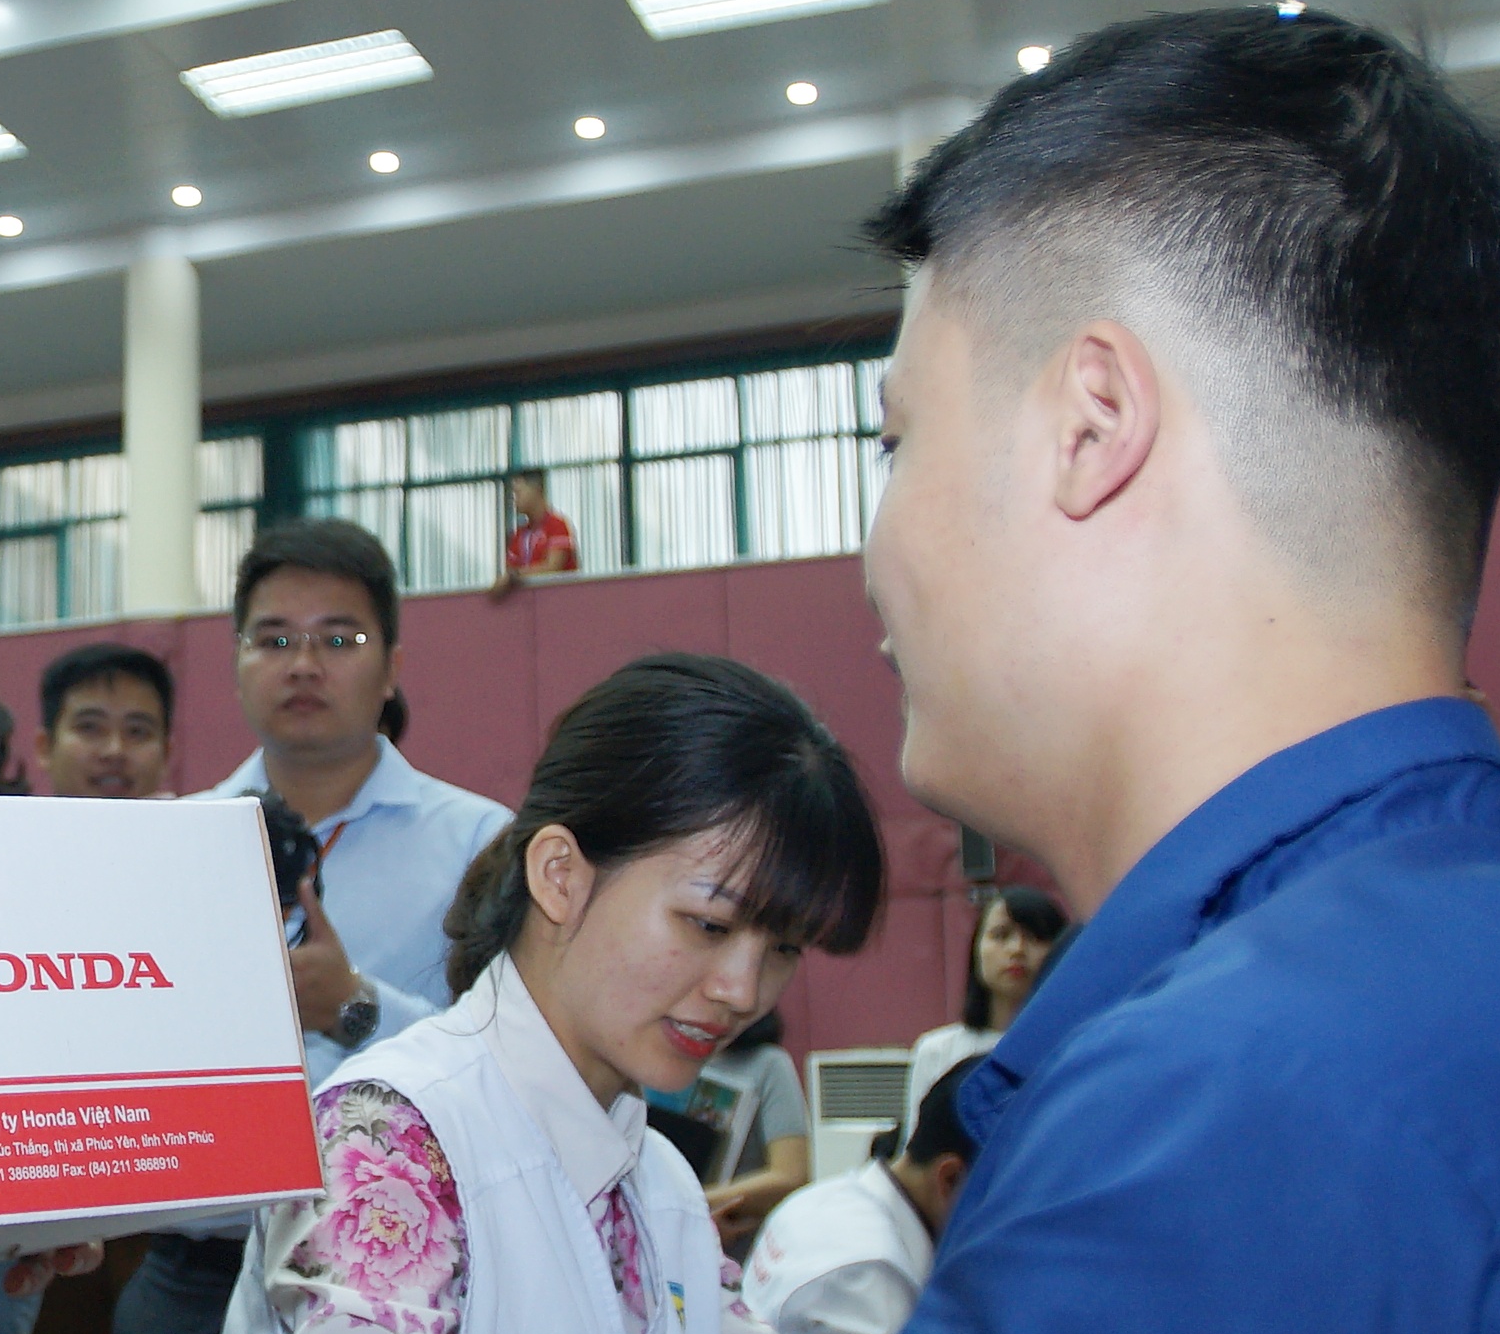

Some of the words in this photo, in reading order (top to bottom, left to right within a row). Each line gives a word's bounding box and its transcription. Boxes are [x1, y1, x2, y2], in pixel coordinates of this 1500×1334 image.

[2, 1112, 17, 1133] ty
[22, 1108, 76, 1127] Honda
[79, 1104, 112, 1128] Việt
[114, 1105, 149, 1124] Nam
[54, 1140, 69, 1155] thị
[70, 1139, 83, 1152] xã
[85, 1137, 113, 1151] Phúc
[115, 1135, 140, 1149] Yên,
[162, 1132, 186, 1146] Vĩnh
[188, 1130, 214, 1144] Phúc
[62, 1163, 87, 1177] Fax:
[88, 1161, 110, 1178] (84)
[112, 1159, 131, 1173] 211
[133, 1156, 179, 1172] 3868910
